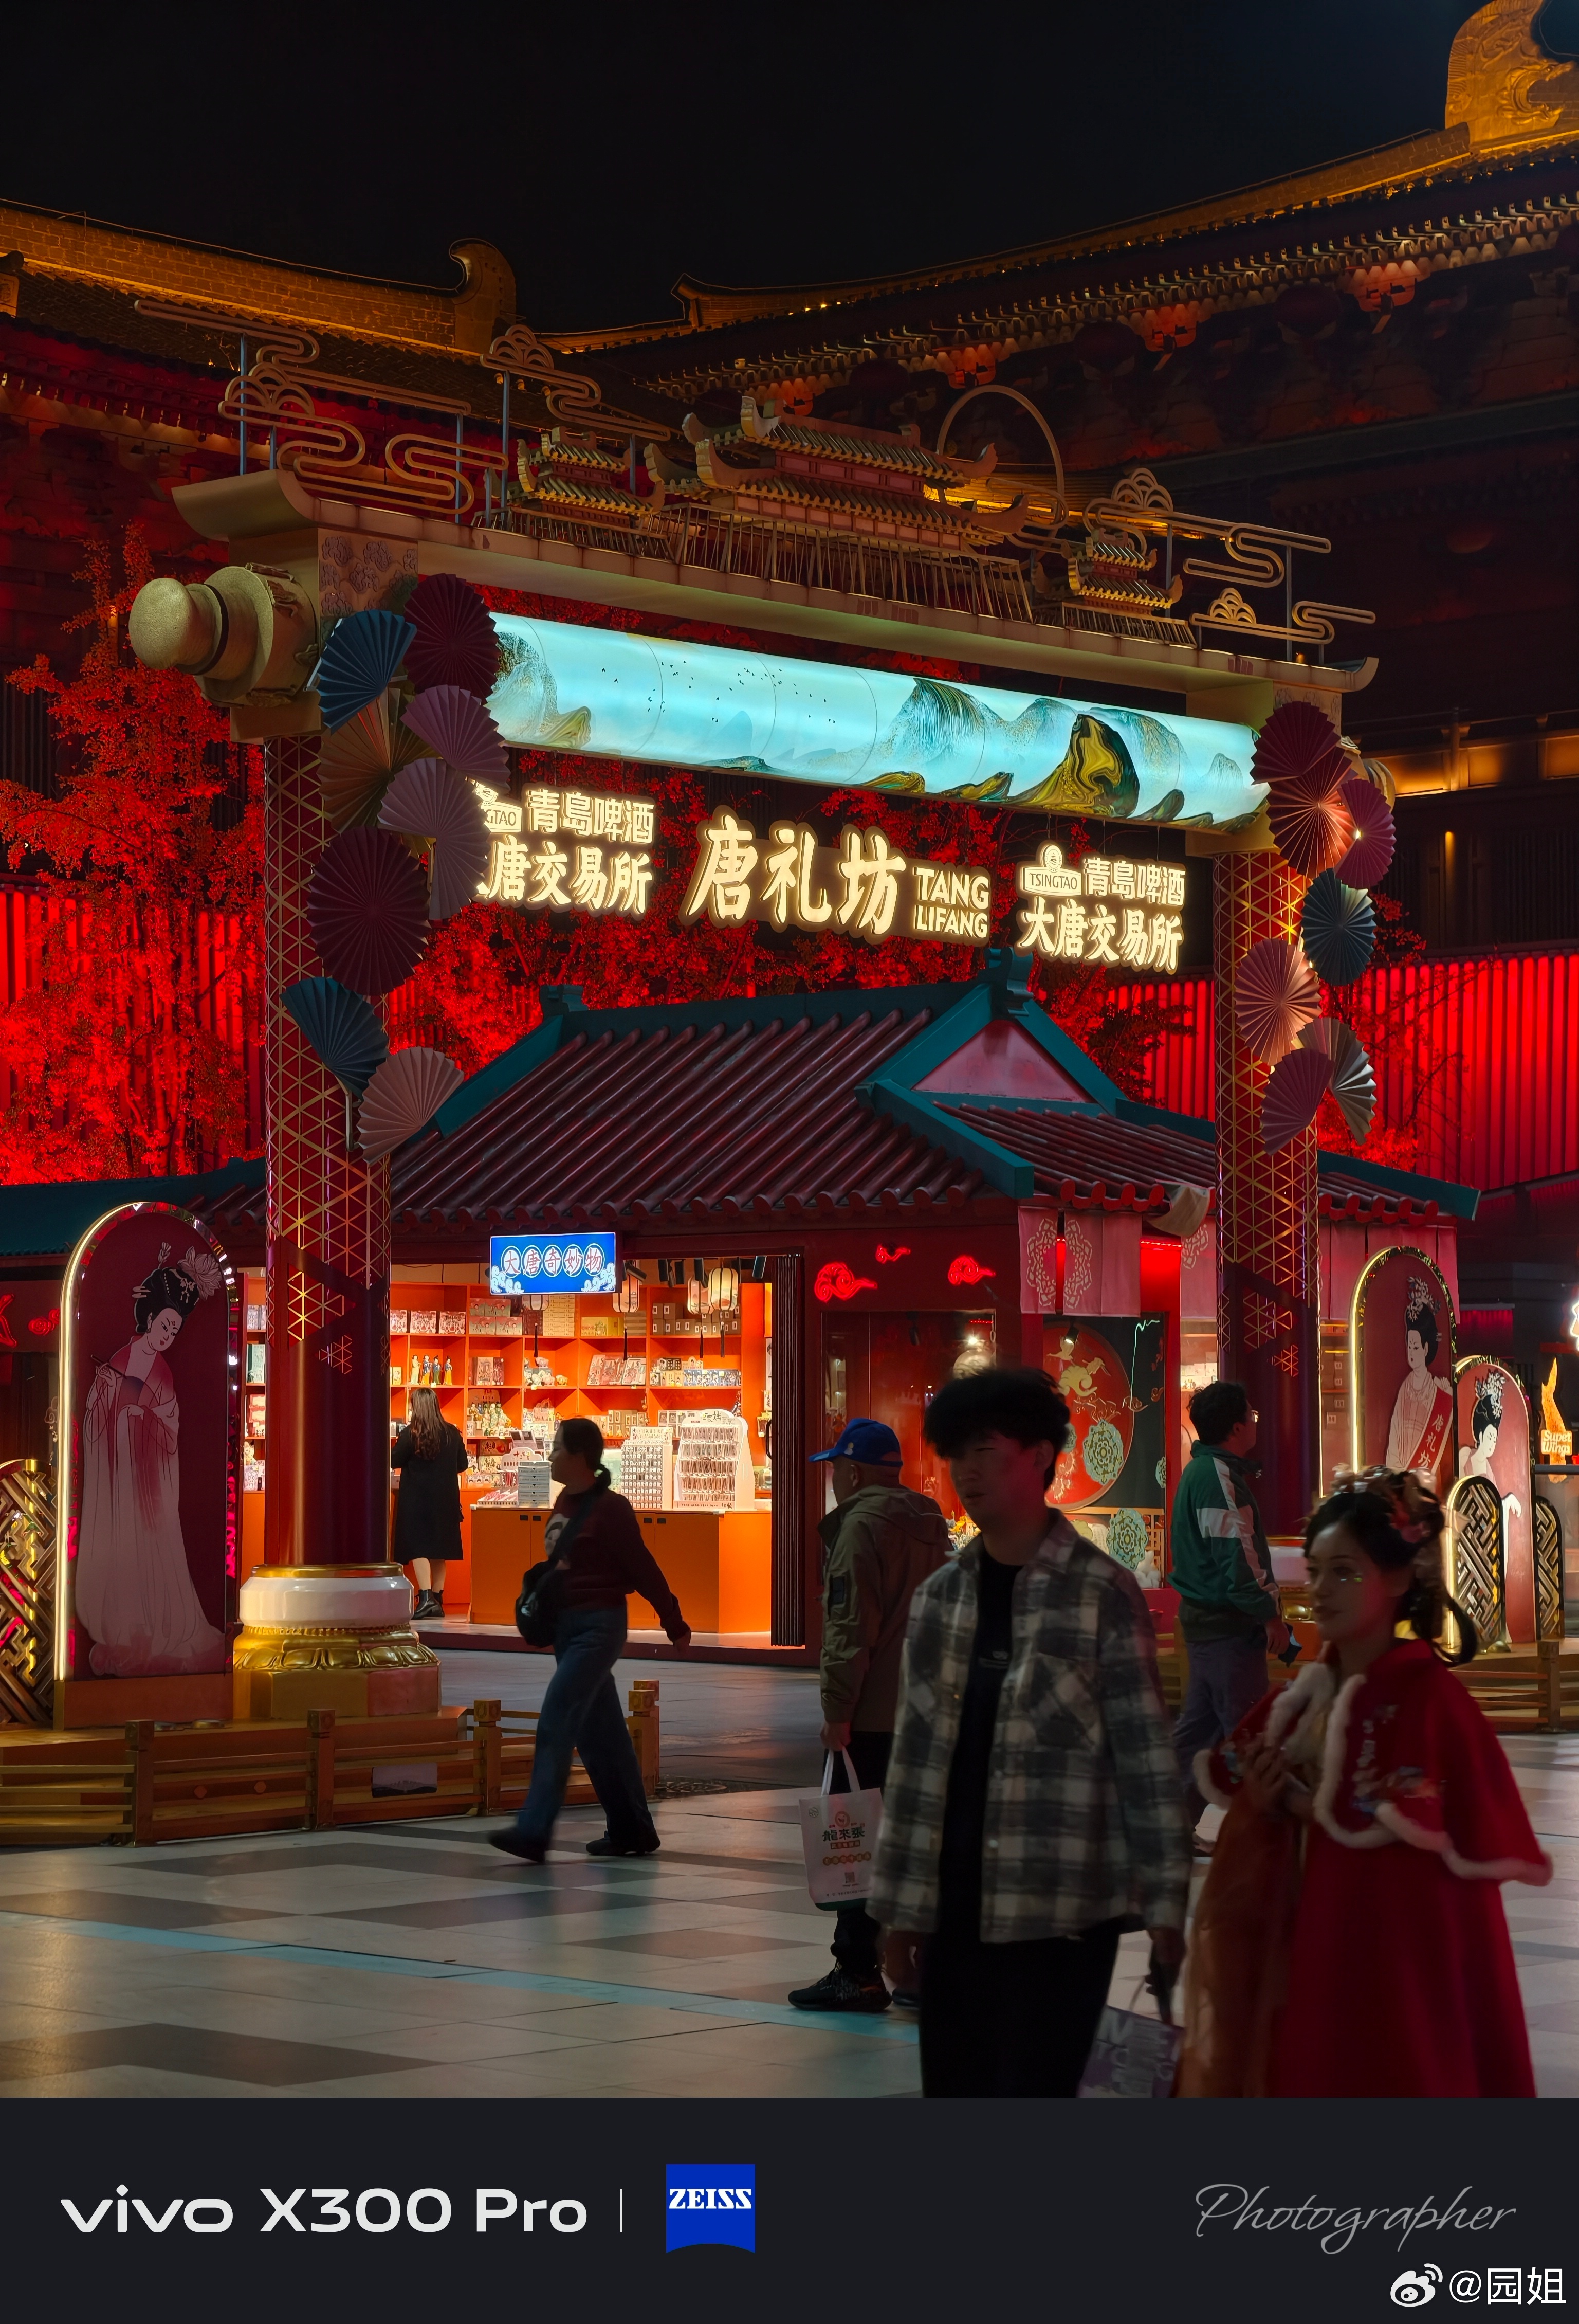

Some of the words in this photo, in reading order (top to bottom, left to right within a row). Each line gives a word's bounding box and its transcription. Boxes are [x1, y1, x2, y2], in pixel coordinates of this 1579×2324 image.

[527, 788, 655, 843] 青島啤酒
[476, 835, 653, 915] 唐交易所
[686, 814, 906, 935] 唐礼坊
[913, 866, 990, 911] TANG
[1029, 873, 1078, 891] TSINGTAO
[1083, 857, 1186, 906] 青島啤酒
[913, 904, 988, 938] LIFANG
[1019, 896, 1182, 970] 大唐交易所
[504, 1247, 602, 1276] 大唐奇妙物
